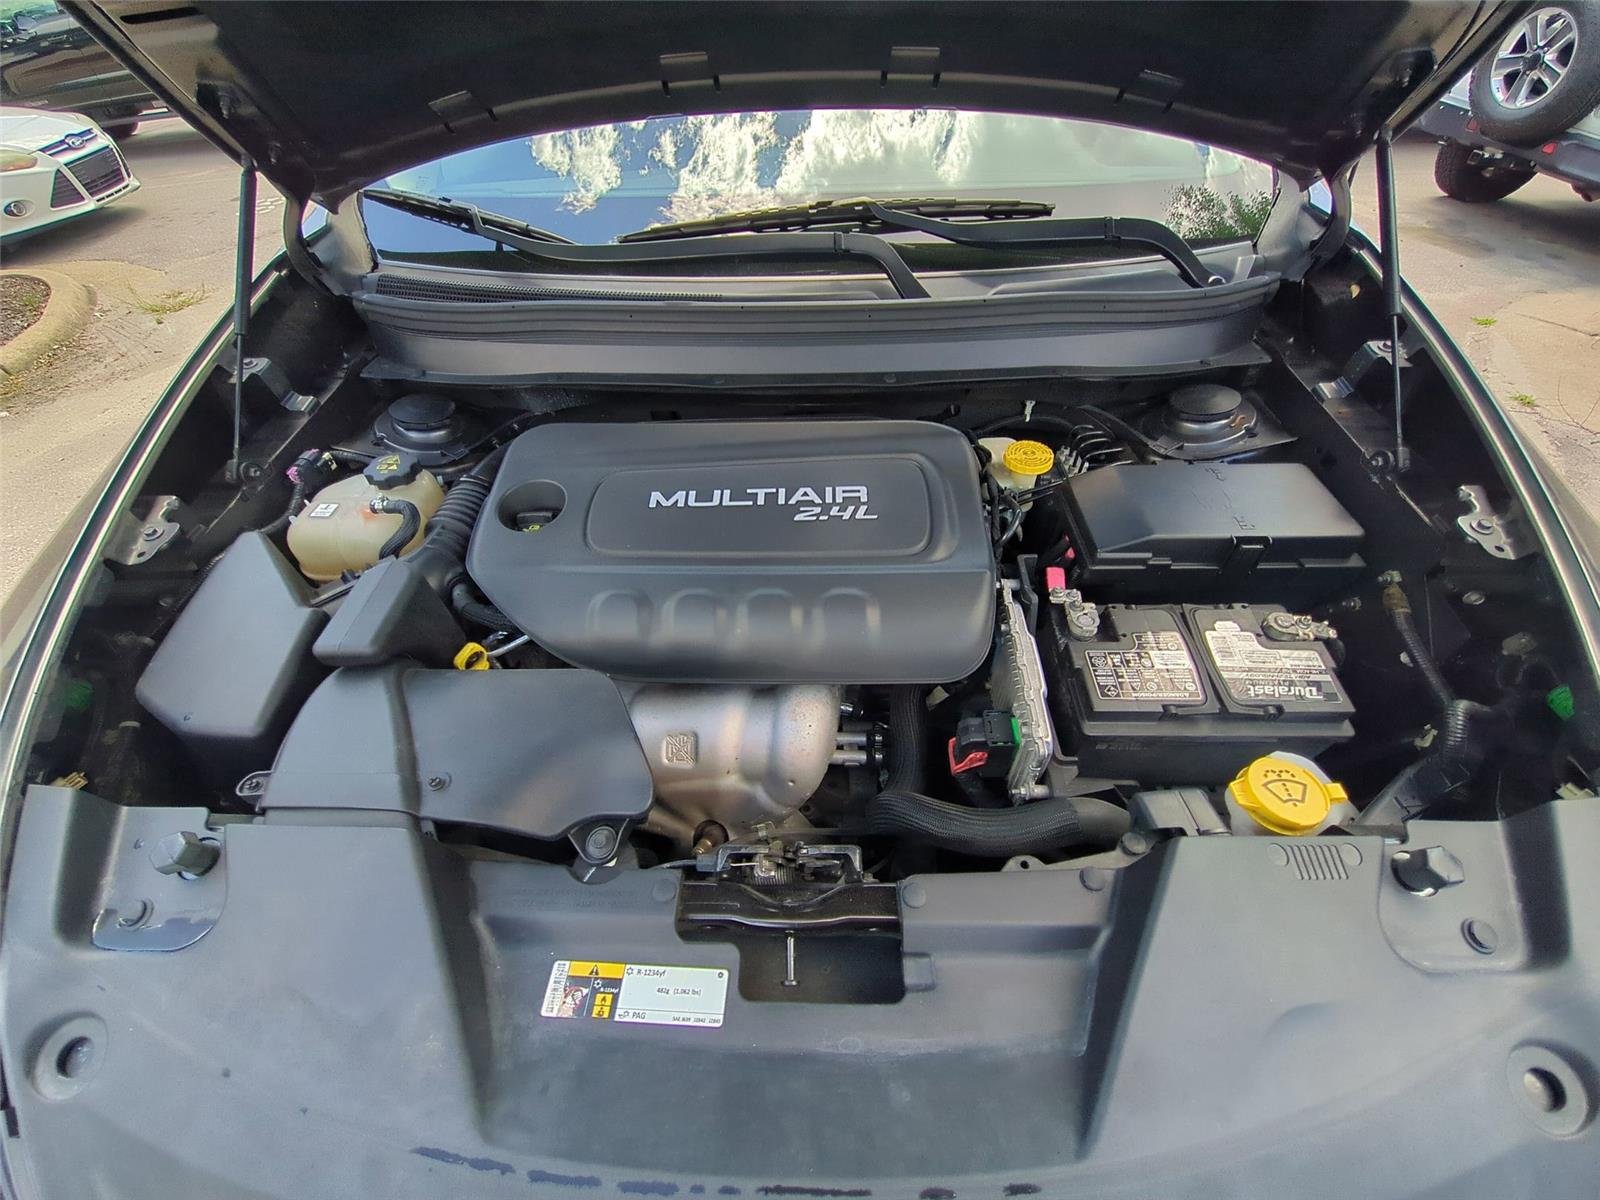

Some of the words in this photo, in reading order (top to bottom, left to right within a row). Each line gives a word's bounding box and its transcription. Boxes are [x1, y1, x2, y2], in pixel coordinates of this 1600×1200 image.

[648, 485, 868, 508] MULTIAIR
[793, 505, 879, 521] 2.4L
[1248, 685, 1323, 699] Duralast
[636, 968, 666, 978] R-1234yf
[631, 1011, 646, 1020] PAG
